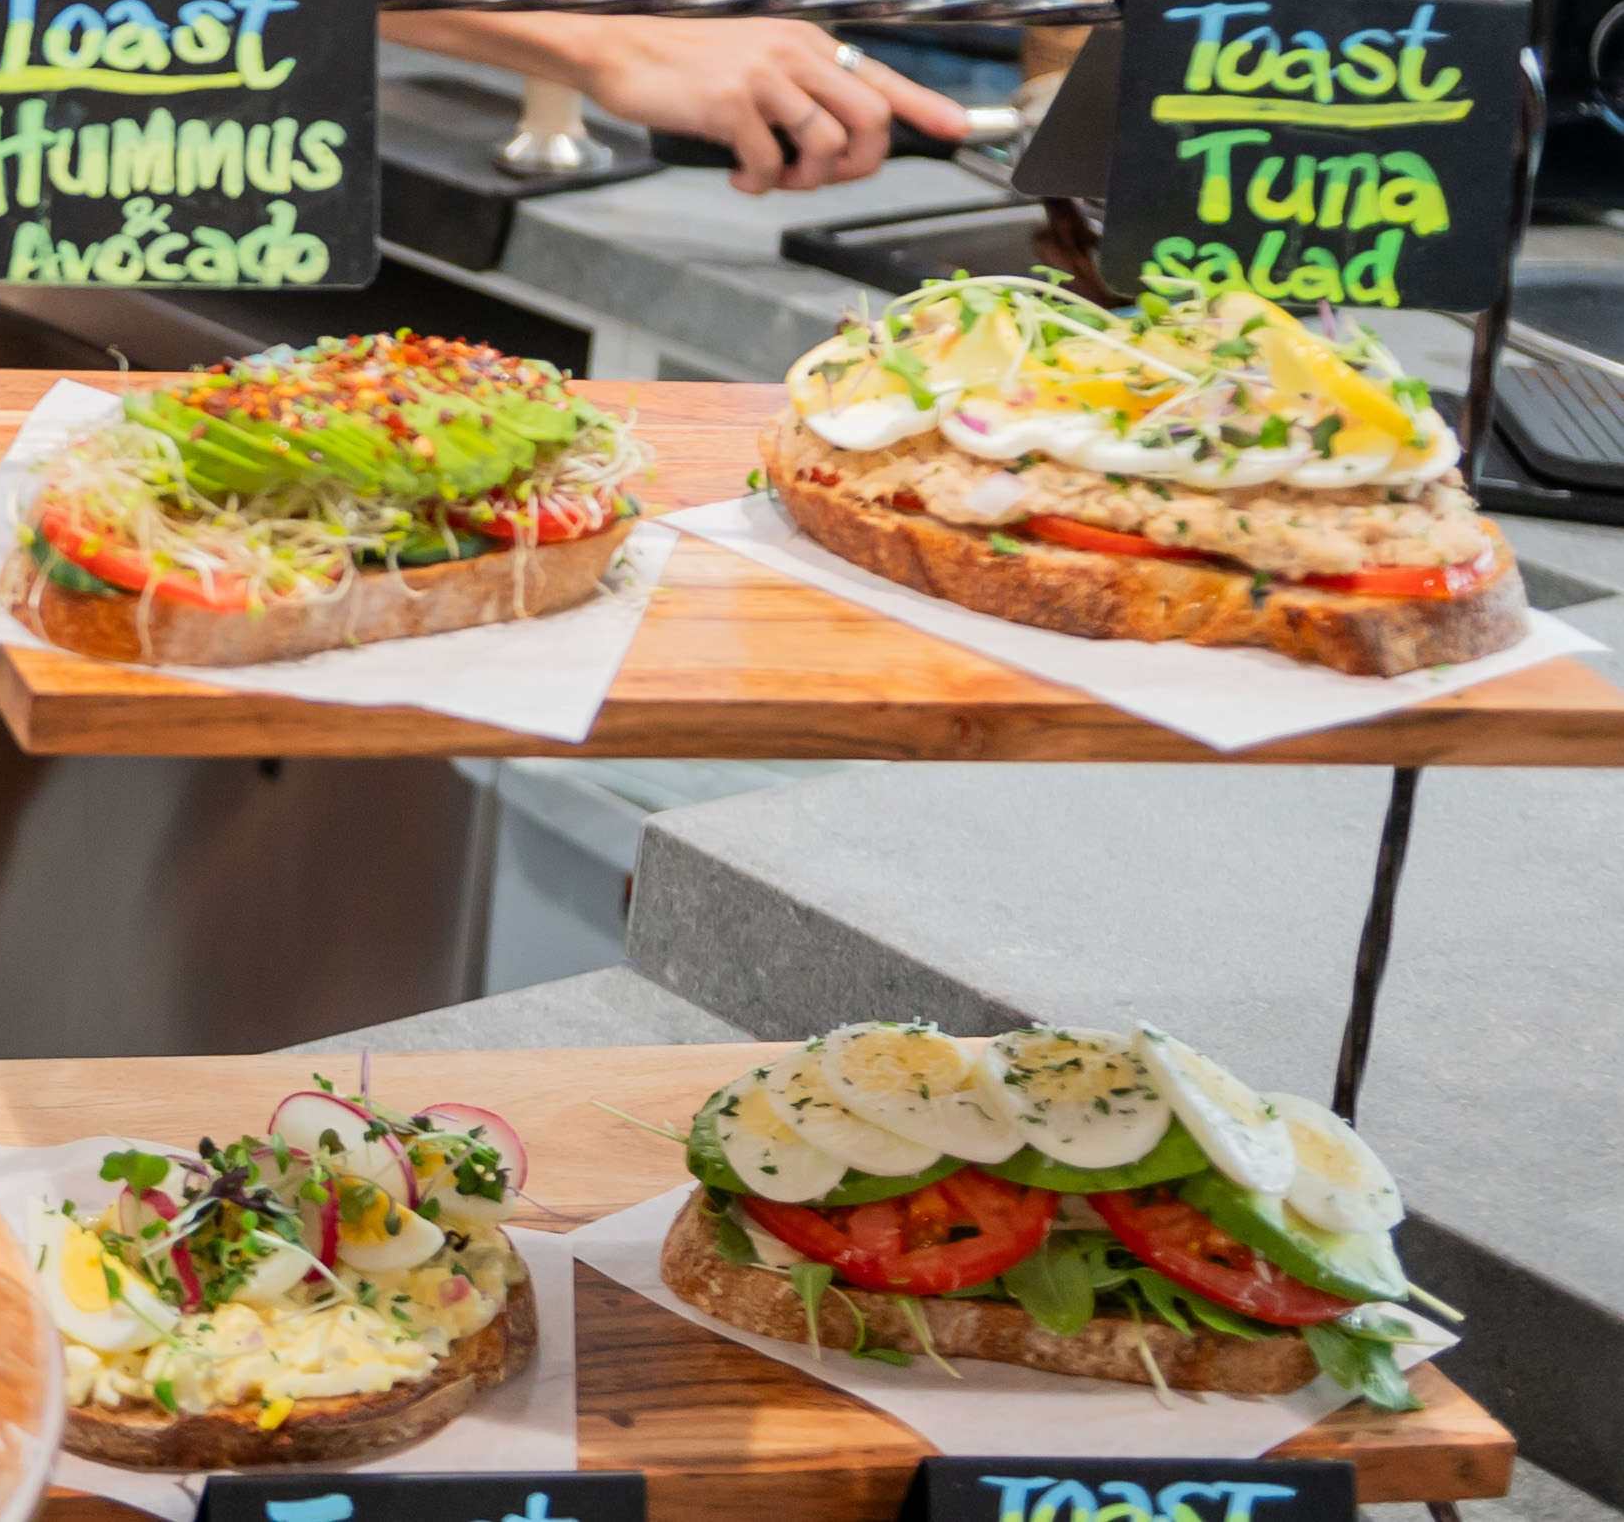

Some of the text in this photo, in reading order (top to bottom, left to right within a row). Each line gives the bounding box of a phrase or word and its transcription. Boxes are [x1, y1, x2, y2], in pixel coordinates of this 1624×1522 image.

[1163, 1, 1462, 103] Toast
[120, 195, 173, 239] &
[1176, 128, 1451, 237] Tuna
[6, 199, 331, 286] Avocado
